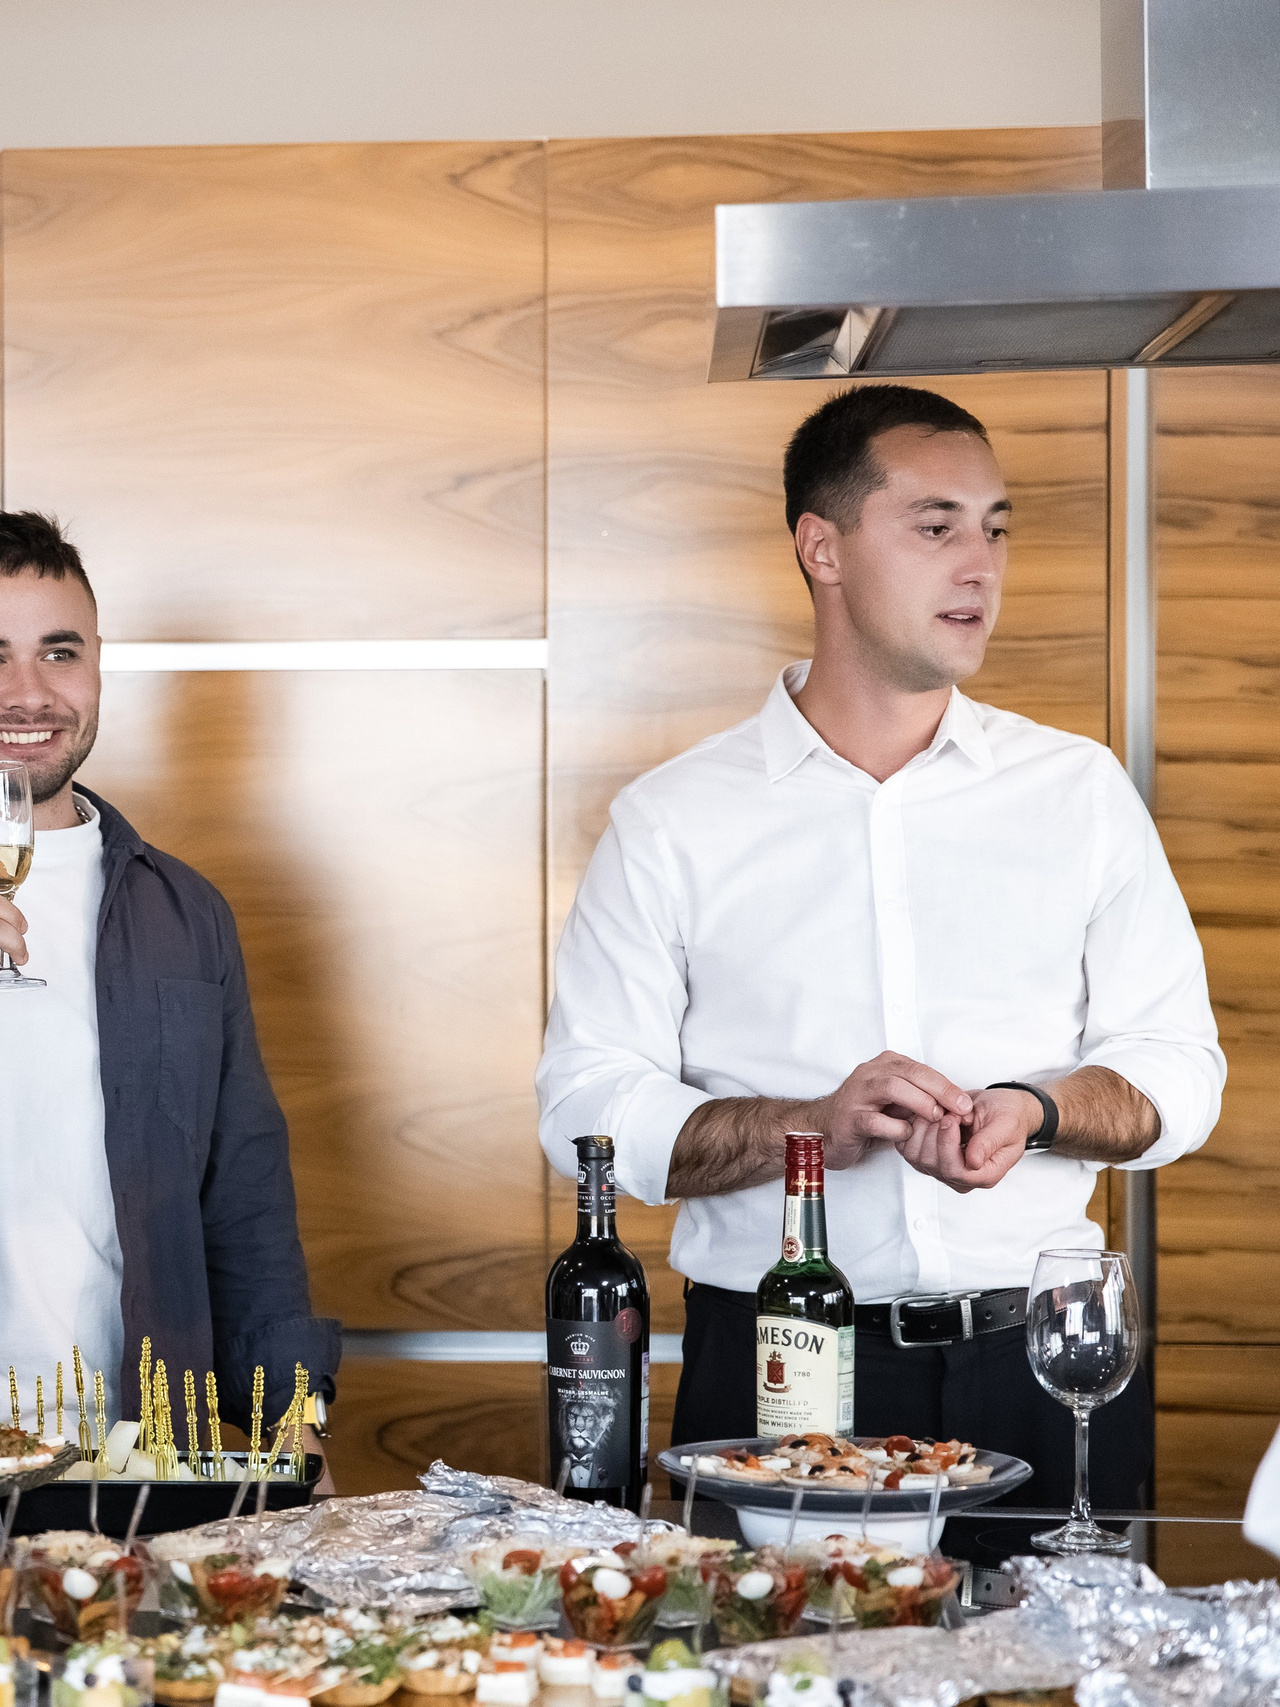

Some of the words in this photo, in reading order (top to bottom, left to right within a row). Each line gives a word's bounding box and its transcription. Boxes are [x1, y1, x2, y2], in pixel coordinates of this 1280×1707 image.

[757, 1326, 825, 1355] AMESON
[549, 1366, 577, 1378] CABERNET
[578, 1369, 626, 1379] SAUVIGNON
